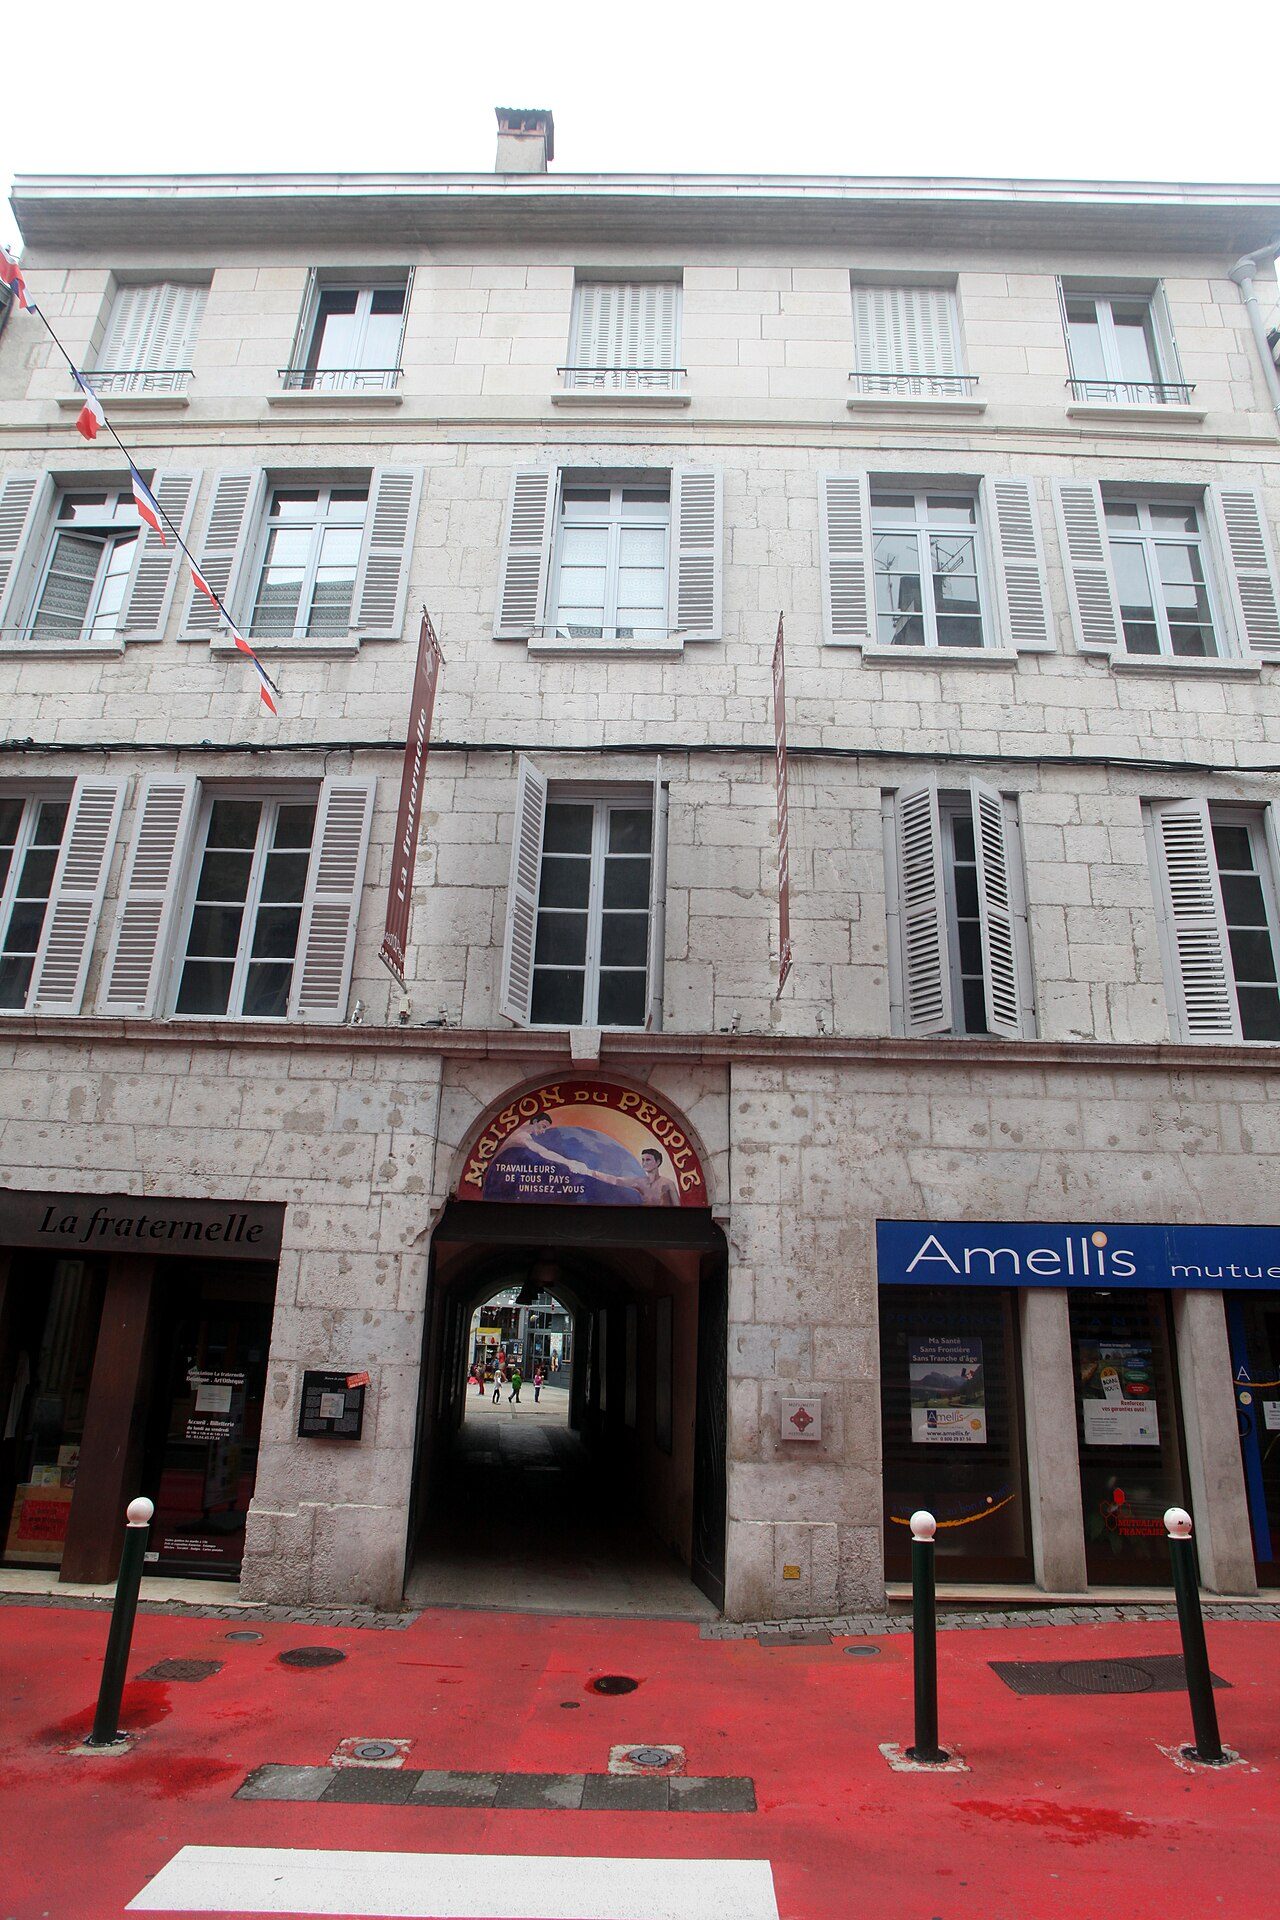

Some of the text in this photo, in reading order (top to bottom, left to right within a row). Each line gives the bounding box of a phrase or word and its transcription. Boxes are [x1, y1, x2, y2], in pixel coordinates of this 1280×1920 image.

[402, 708, 427, 858] fraternelle
[464, 1085, 702, 1192] MAISON DU PEUPLE
[495, 1163, 557, 1175] TRAVAILLEURS
[505, 1174, 571, 1184] DE TOUS PAYS
[38, 1206, 264, 1243] La fraternelle
[906, 1231, 1137, 1278] Amellis
[920, 1345, 970, 1353] Sans Frontière
[912, 1354, 928, 1362] Sans
[959, 1355, 978, 1364] d'âge
[928, 1410, 964, 1422] Amellis
